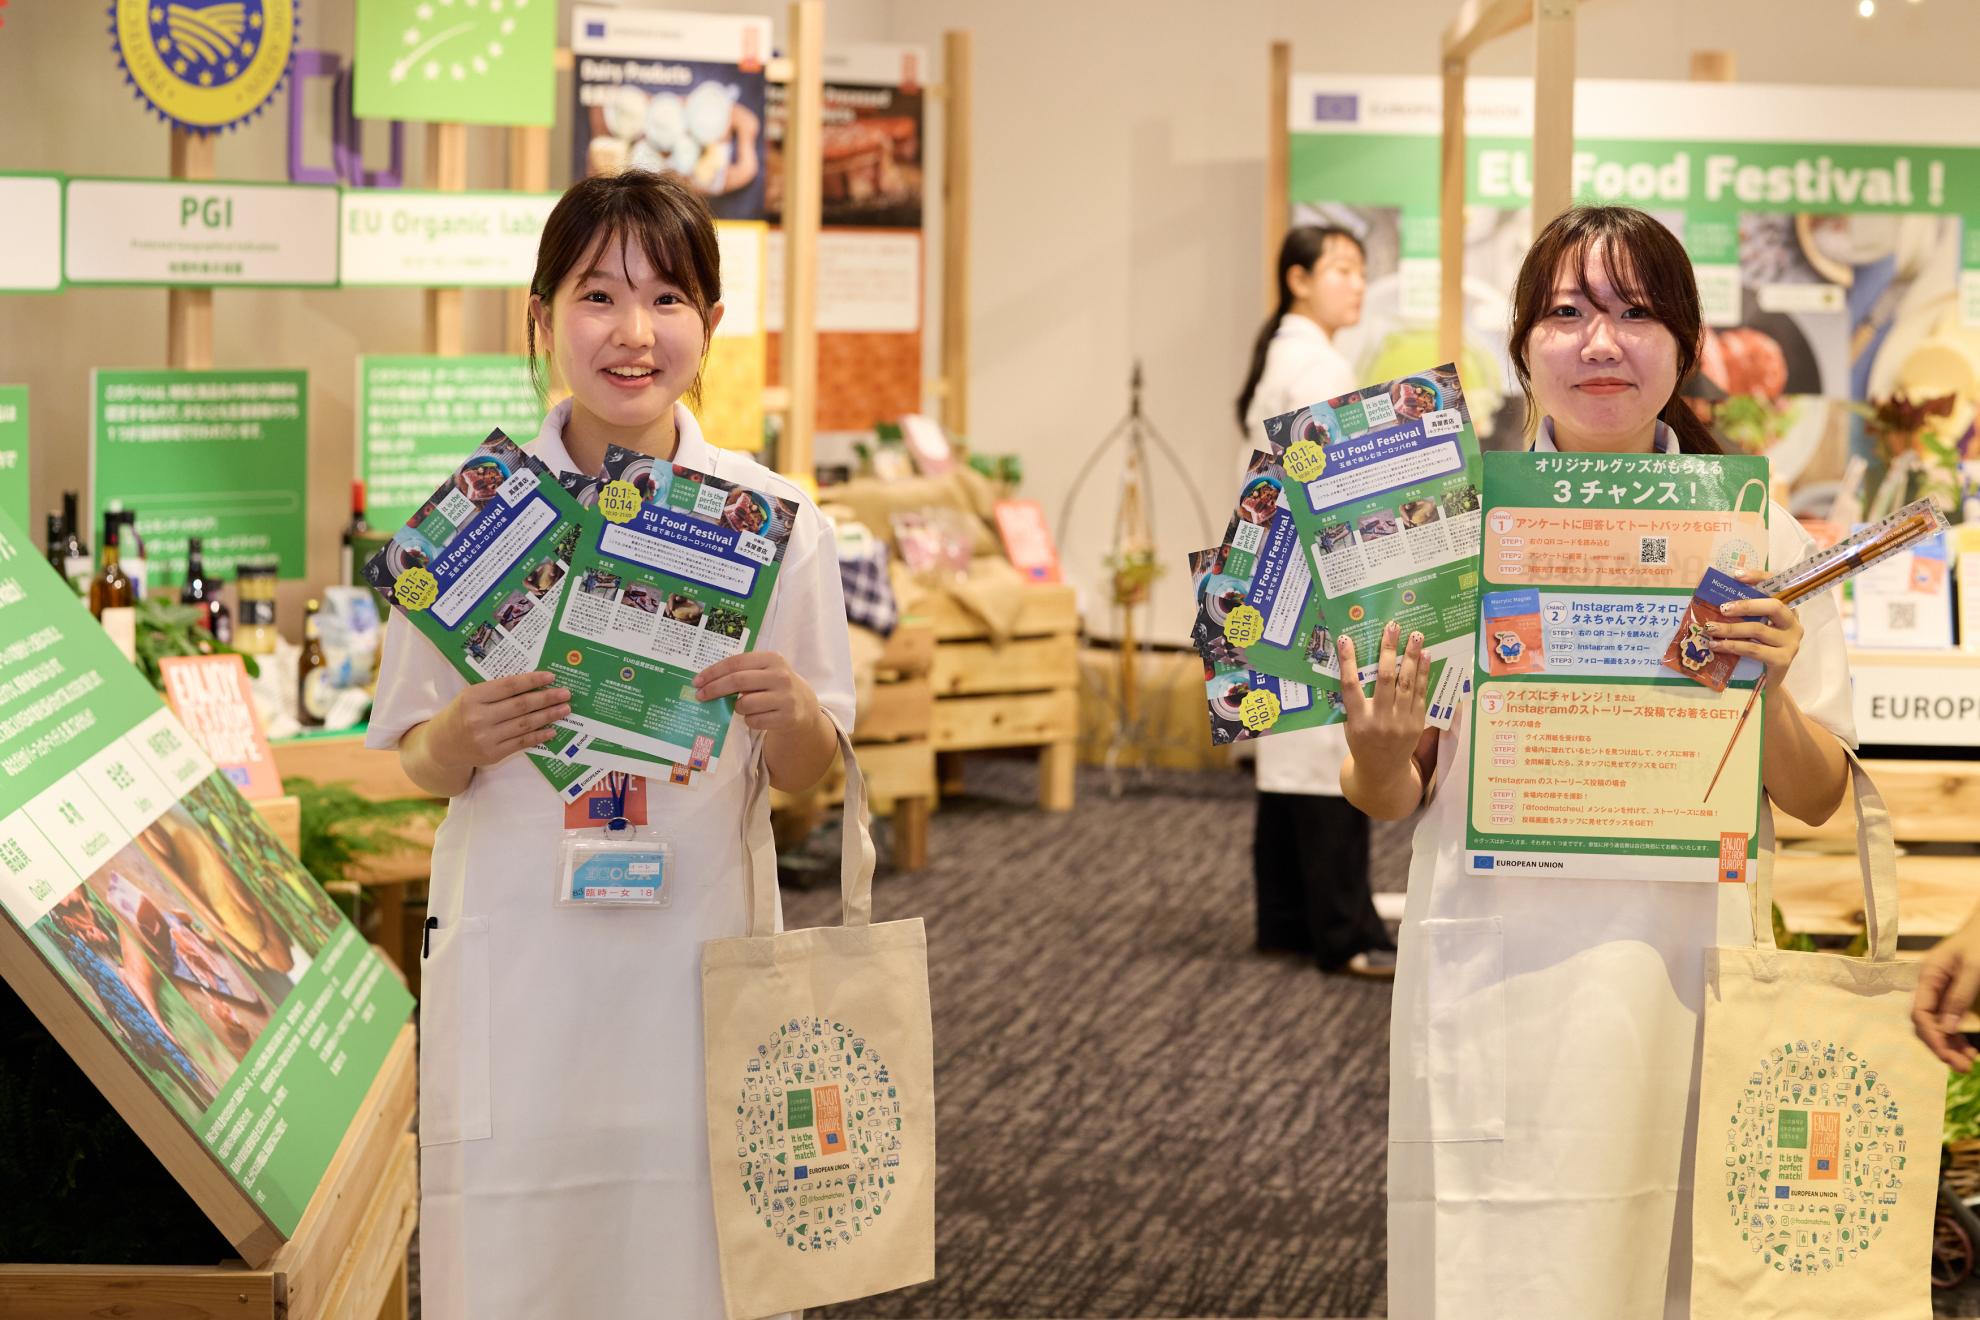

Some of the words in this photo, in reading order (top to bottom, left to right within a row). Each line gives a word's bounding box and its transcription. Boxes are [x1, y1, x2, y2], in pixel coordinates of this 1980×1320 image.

[1574, 149, 1690, 199] Food
[1706, 155, 1912, 204] Festival
[181, 197, 233, 228] PGI
[349, 208, 382, 234] EU
[392, 208, 490, 242] Organic
[1367, 405, 1391, 416] perfect
[1330, 450, 1346, 462] EU
[1347, 439, 1375, 456] Food
[1377, 427, 1421, 447] Festival
[1290, 456, 1318, 475] 10.14
[1535, 457, 1723, 475] オリジナルグッズがもらえる
[447, 498, 466, 519] perfect
[604, 498, 633, 511] 10.14
[699, 497, 721, 508] perfect
[642, 510, 659, 522] EU
[660, 515, 688, 532] Food
[689, 524, 733, 547] Festival
[435, 560, 450, 576] EU
[447, 538, 471, 562] Food
[468, 503, 506, 541] Festival
[1243, 526, 1254, 549] perfect
[1252, 588, 1264, 604] EU
[1259, 560, 1274, 587] Food
[1268, 514, 1290, 558] Festival
[406, 578, 429, 605] 10.14
[1551, 611, 1559, 622] 2
[1239, 614, 1253, 642] 10.14
[1254, 696, 1270, 726] 10.14
[1870, 694, 1980, 720] EUROP
[570, 719, 585, 728] UNION
[1722, 837, 1746, 851] ENJOY
[1496, 860, 1537, 868] EUROPEAN
[1538, 861, 1564, 869] UNION
[1721, 859, 1745, 870] EUROPE
[1814, 1114, 1839, 1132] ENJOY
[803, 1132, 813, 1141] the
[793, 1141, 815, 1153] perfect
[1811, 1143, 1837, 1158] EUROPE
[795, 1150, 817, 1161] match!
[1793, 1154, 1804, 1163] the
[808, 1165, 834, 1175] EUROPEAN
[835, 1163, 850, 1171] UNION
[1779, 1163, 1802, 1173] perfect
[1778, 1172, 1803, 1181] match!
[1790, 1190, 1818, 1198] EUROPEAN
[1819, 1191, 1838, 1199] UNION
